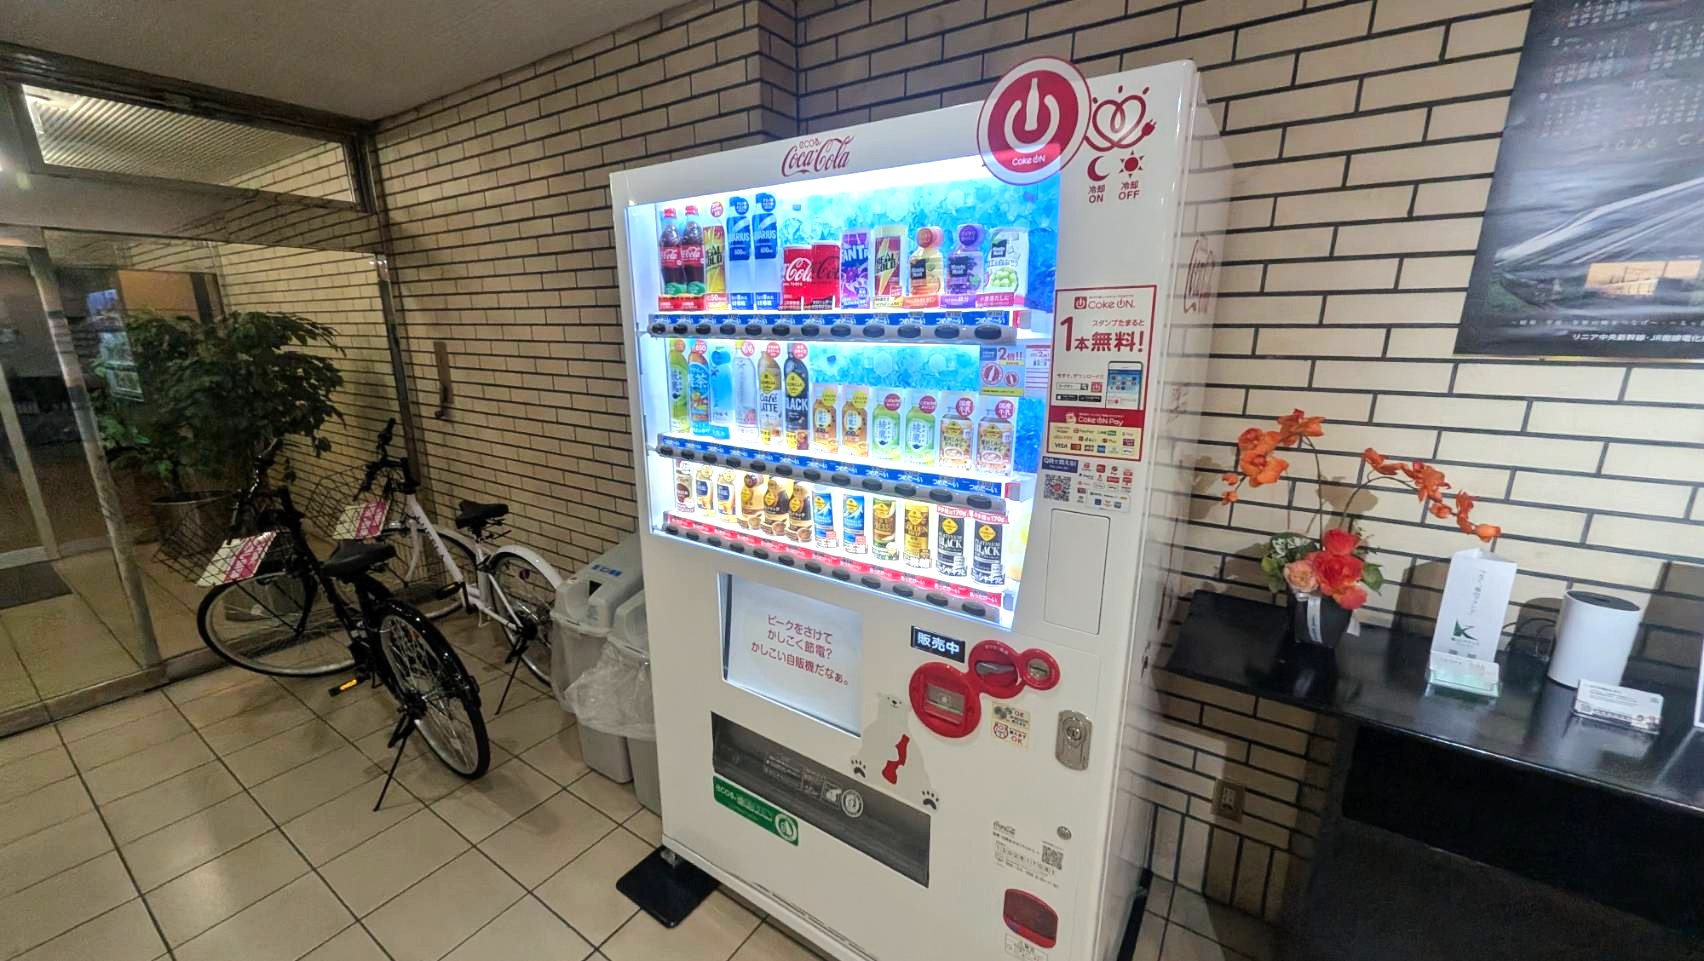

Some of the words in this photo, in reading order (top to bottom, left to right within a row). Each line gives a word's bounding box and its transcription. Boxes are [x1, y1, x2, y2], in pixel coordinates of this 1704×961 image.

[781, 136, 854, 177] Coca-Cola
[1011, 157, 1033, 167] Coke
[1033, 153, 1047, 165] ON
[1088, 185, 1106, 194] 冷却
[1121, 180, 1139, 190] 冷却
[1088, 194, 1105, 203] ON
[1118, 189, 1140, 200] OFF
[1088, 300, 1115, 310] Coke
[1092, 319, 1145, 327] スタンプたまると
[768, 614, 833, 645] ピークをさけて
[917, 631, 960, 655] 販売中
